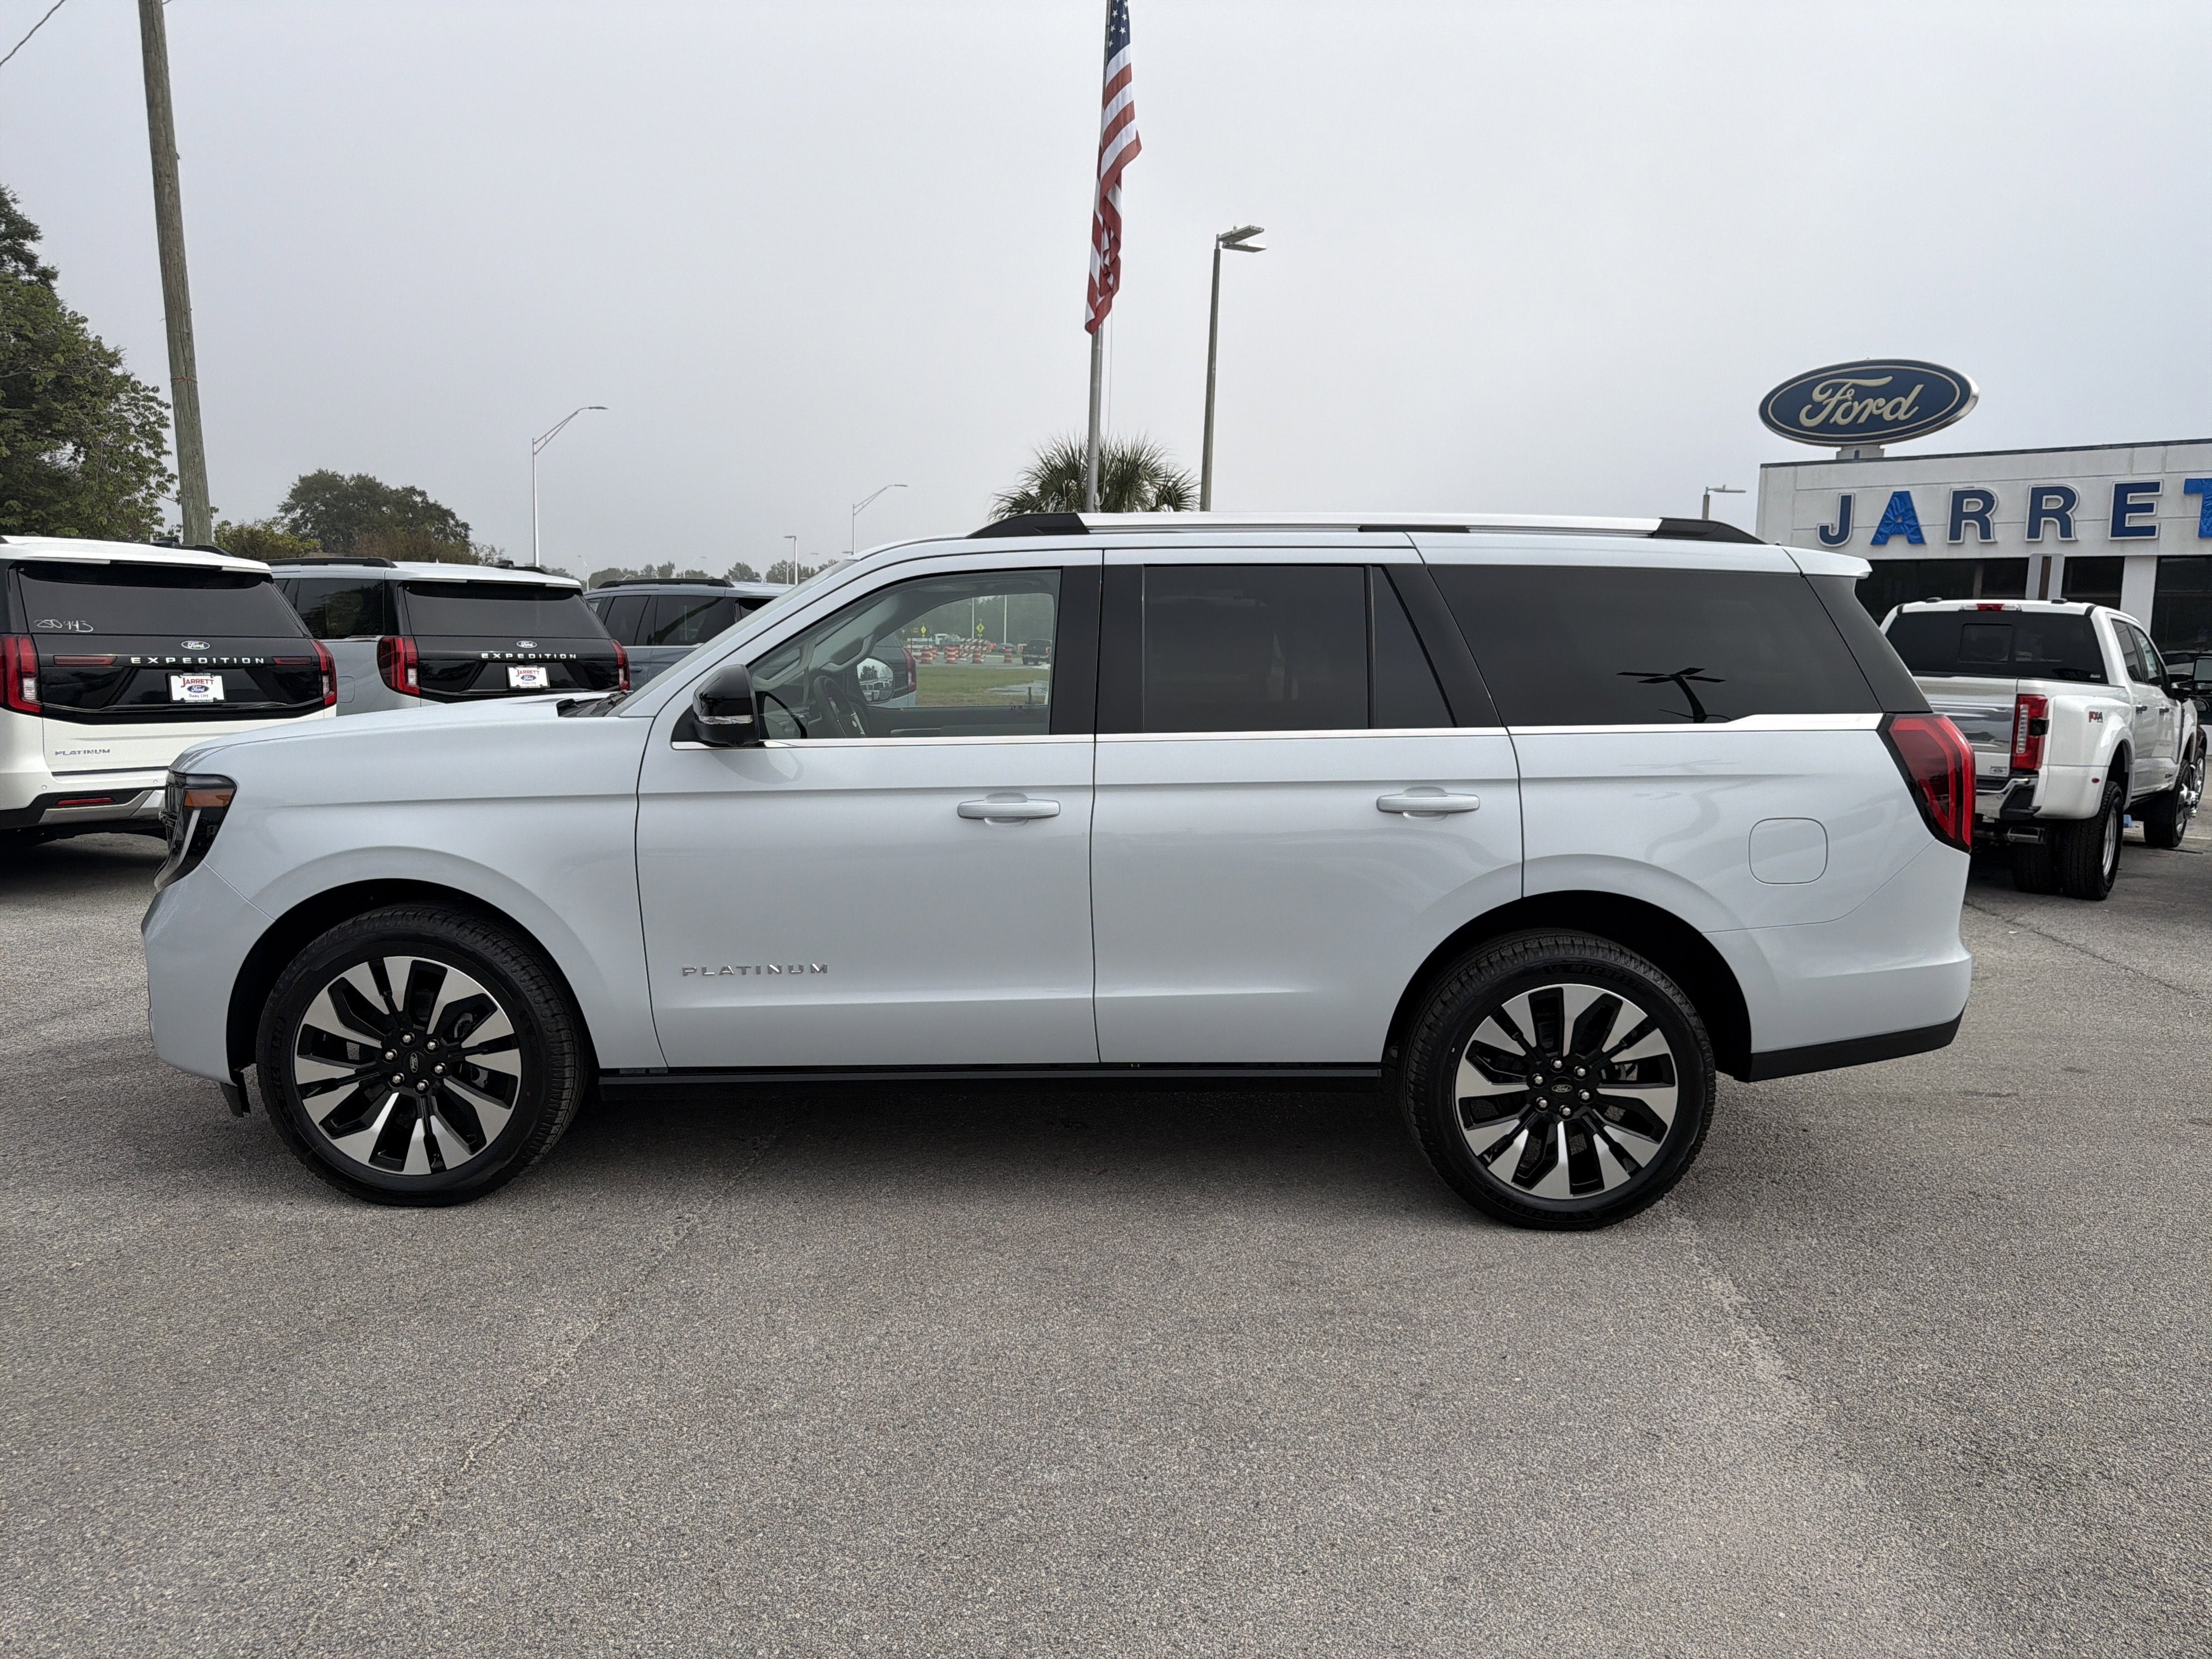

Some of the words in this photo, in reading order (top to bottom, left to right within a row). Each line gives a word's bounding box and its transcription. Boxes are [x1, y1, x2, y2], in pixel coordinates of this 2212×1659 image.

[1799, 376, 1925, 427] Ford
[516, 669, 540, 677] JARRETT
[180, 678, 215, 688] JARRETT
[682, 963, 828, 976] PLATINUM
